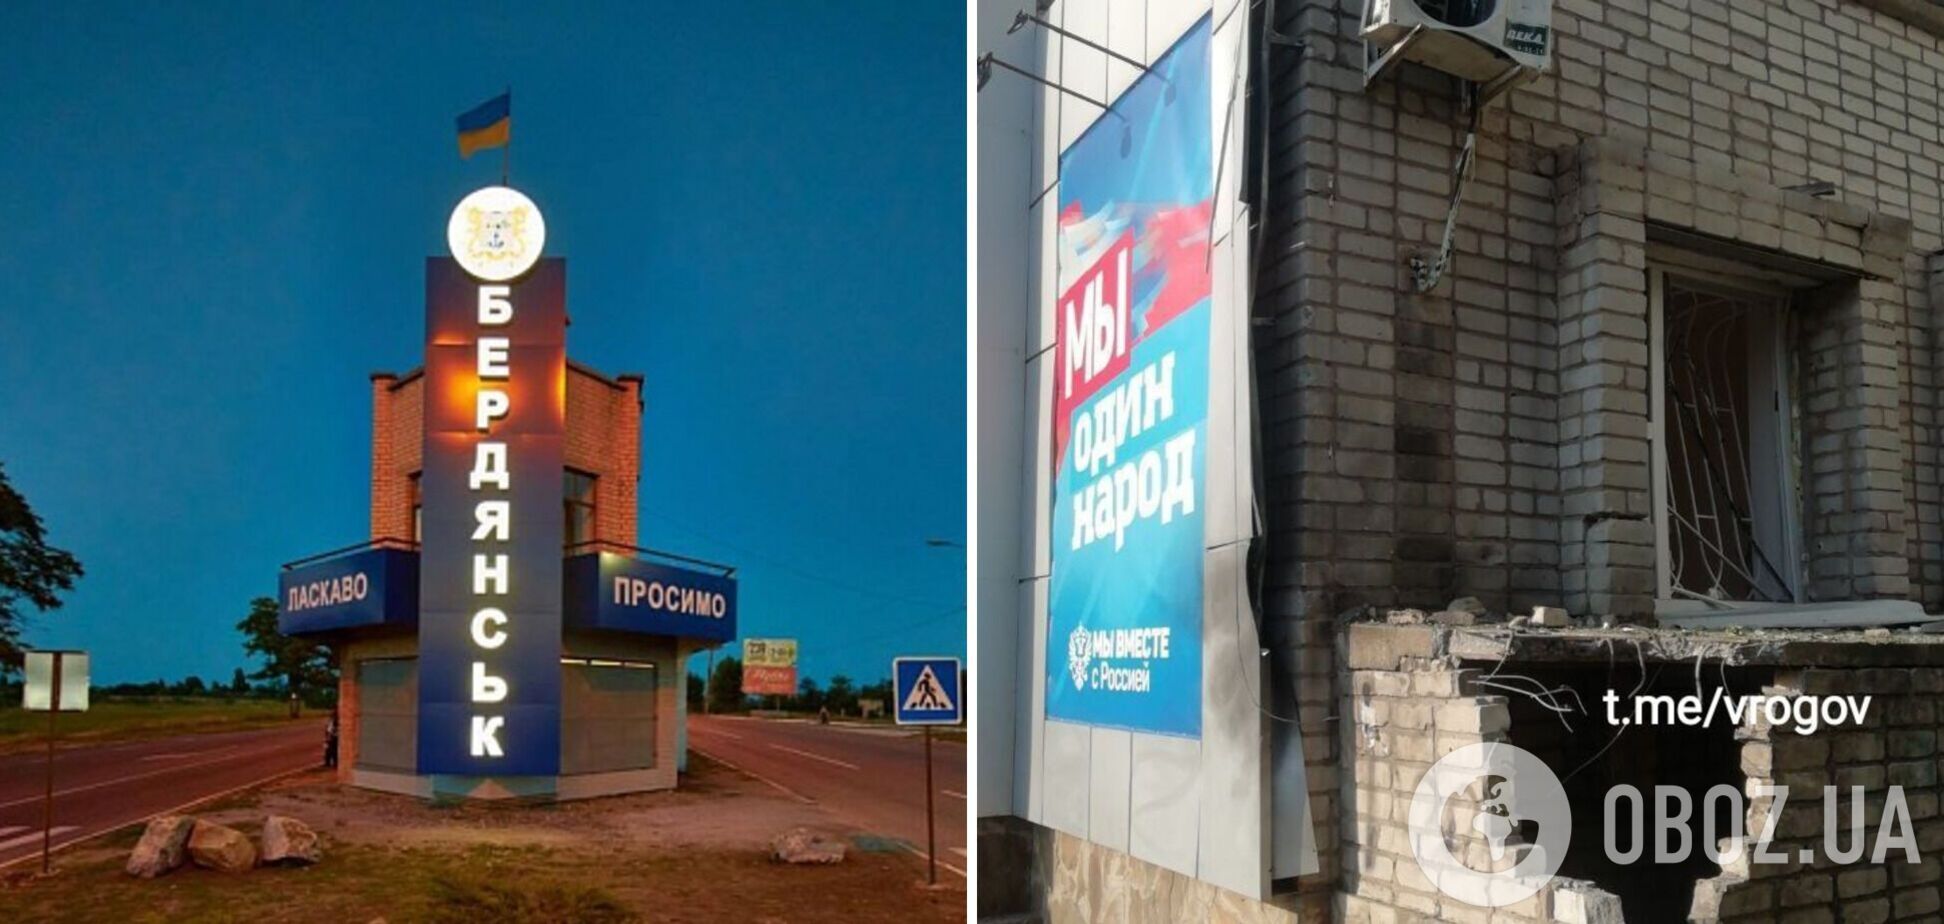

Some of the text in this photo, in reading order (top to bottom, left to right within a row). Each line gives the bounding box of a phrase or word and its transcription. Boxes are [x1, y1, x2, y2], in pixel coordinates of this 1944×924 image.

[1065, 247, 1128, 400] МЫ
[1074, 350, 1176, 477] один
[469, 285, 513, 758] БЕРДЯНСЬК
[1071, 428, 1196, 553] народ
[287, 571, 368, 612] ЛАСКАВО
[614, 576, 726, 618] ПРОСИМО
[1091, 661, 1150, 693] с Россией
[1093, 626, 1170, 660] МЫ ВМЕСТЕ
